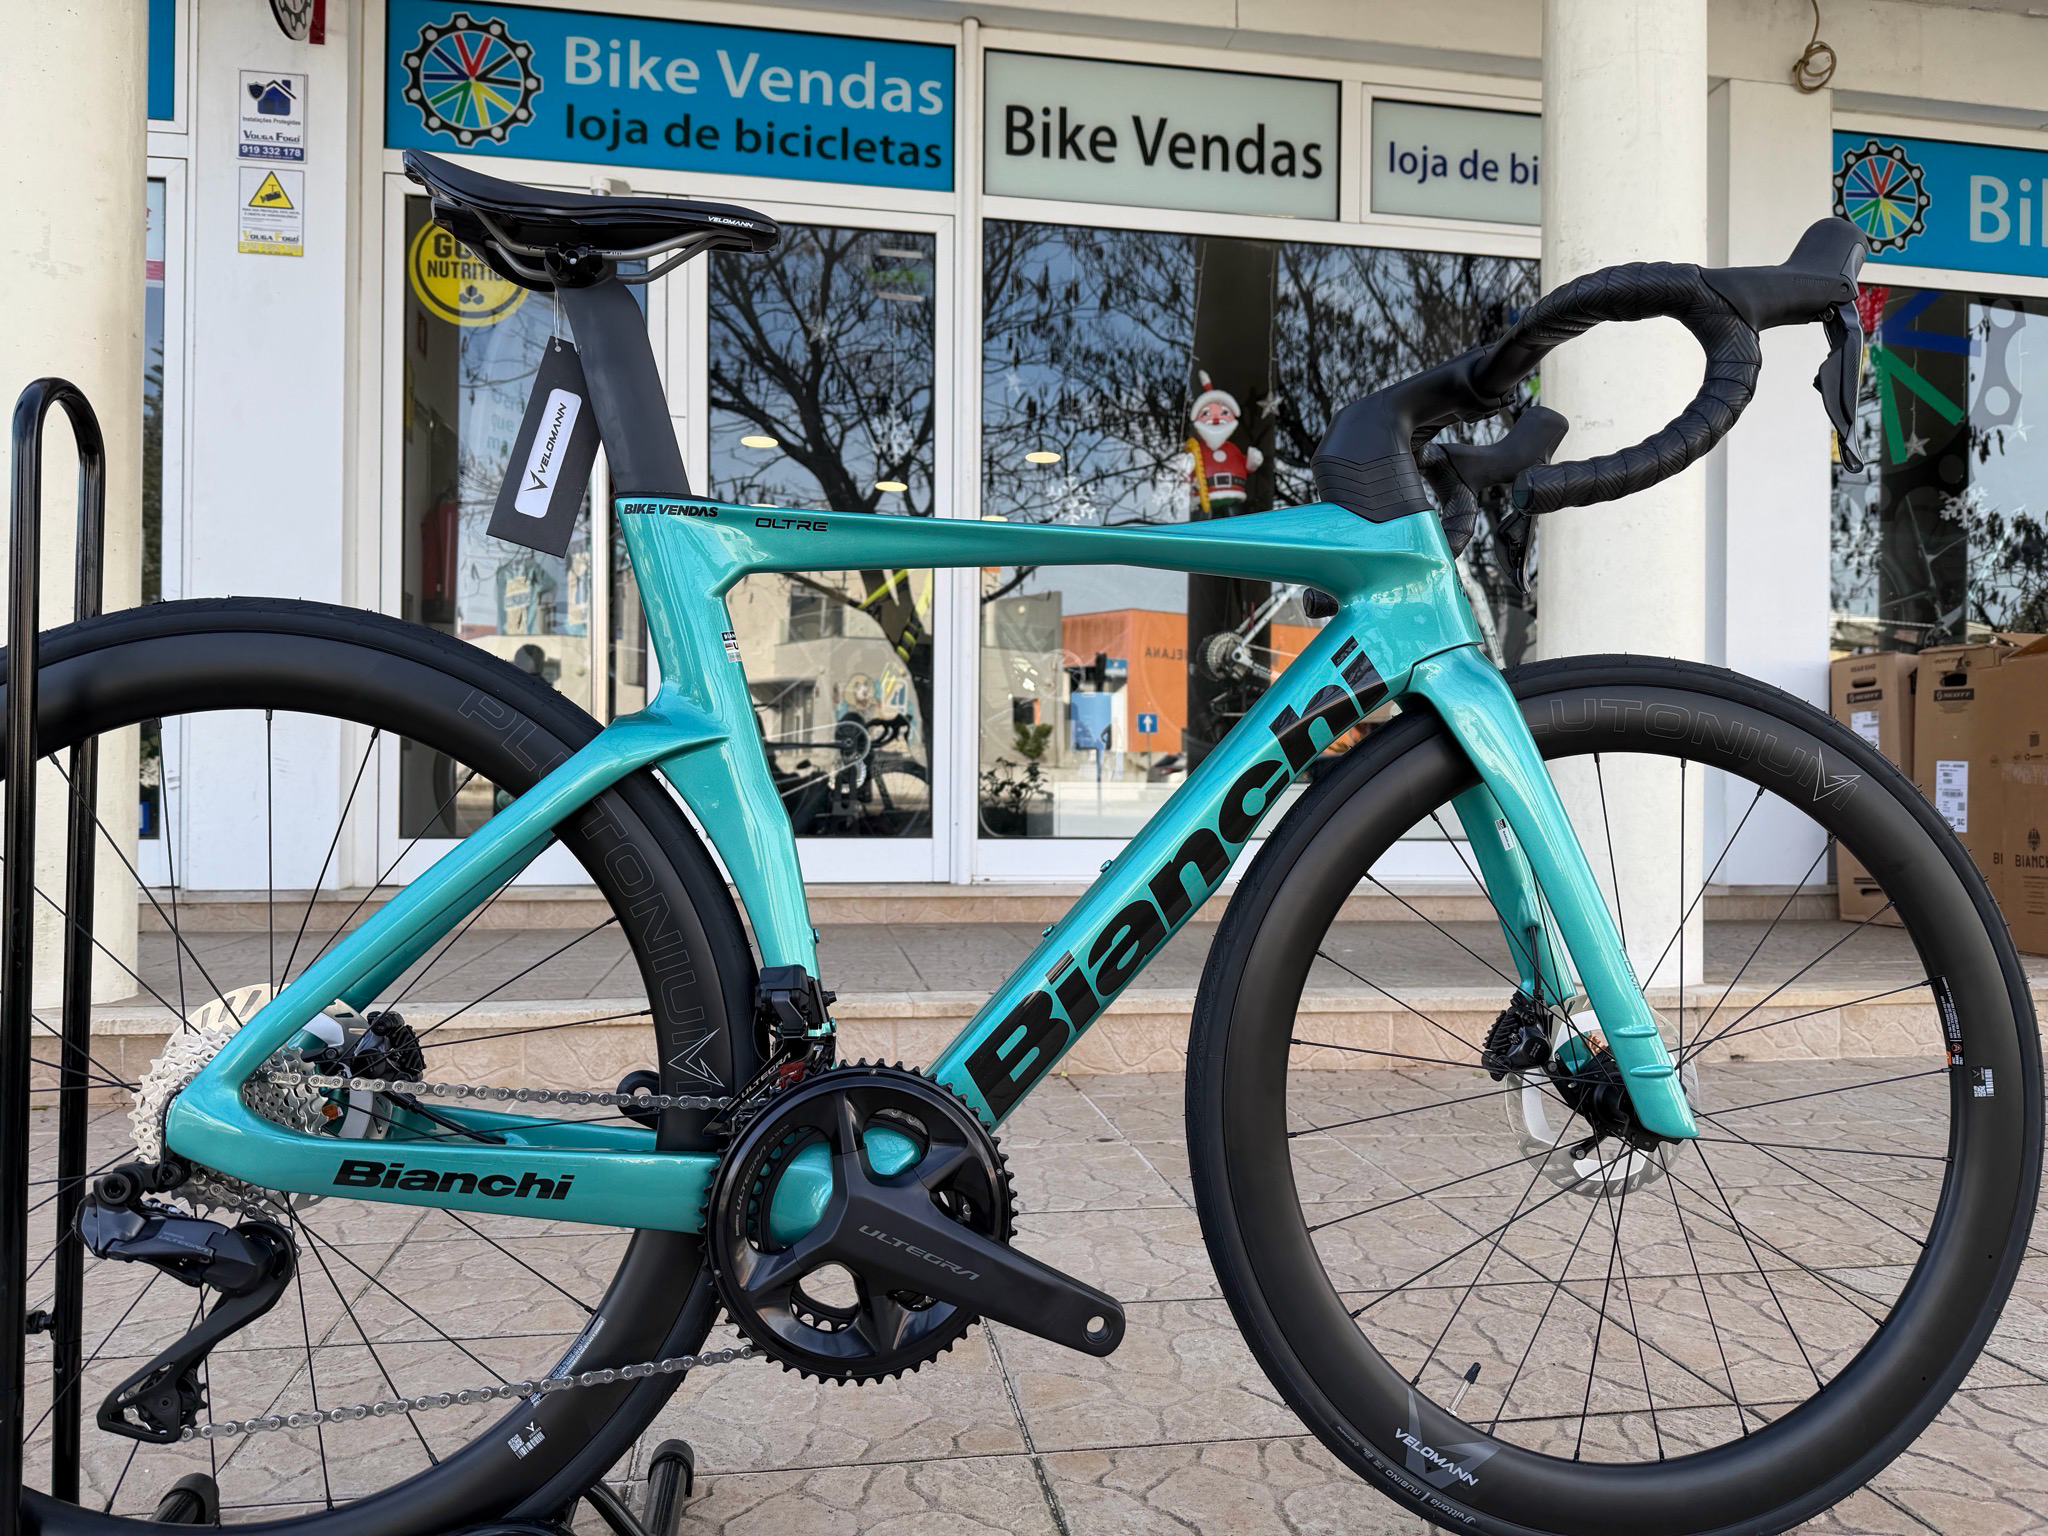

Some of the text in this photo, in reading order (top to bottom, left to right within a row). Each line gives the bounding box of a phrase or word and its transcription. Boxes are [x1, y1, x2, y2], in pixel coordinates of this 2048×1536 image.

[565, 36, 943, 116] Bike Vendas
[241, 145, 260, 153] 919
[262, 146, 280, 156] 332
[283, 148, 301, 157] 178
[566, 104, 942, 169] loja de bicicletas
[1004, 104, 1323, 179] Bike Vendas
[1389, 141, 1447, 184] loja
[1459, 149, 1499, 181] de
[708, 215, 754, 228] VELOMANN
[1969, 174, 2048, 248] Bi
[537, 402, 567, 474] VELOMANN
[623, 503, 719, 518] BIKE VENDAS
[755, 517, 829, 532] OLTRE
[1521, 698, 1862, 812] LUTONIUM
[457, 688, 724, 1098] PLTONIUM
[964, 635, 1390, 1121] Bianchi
[741, 1052, 791, 1099] ULTEGRA
[332, 1159, 576, 1200] Bianchi
[736, 1145, 767, 1211] ULTEGRA
[858, 1224, 980, 1281] ULTEGRA
[1394, 1427, 1480, 1487] VELOMANN
[1385, 1469, 1465, 1520] vittoria RUBINO
